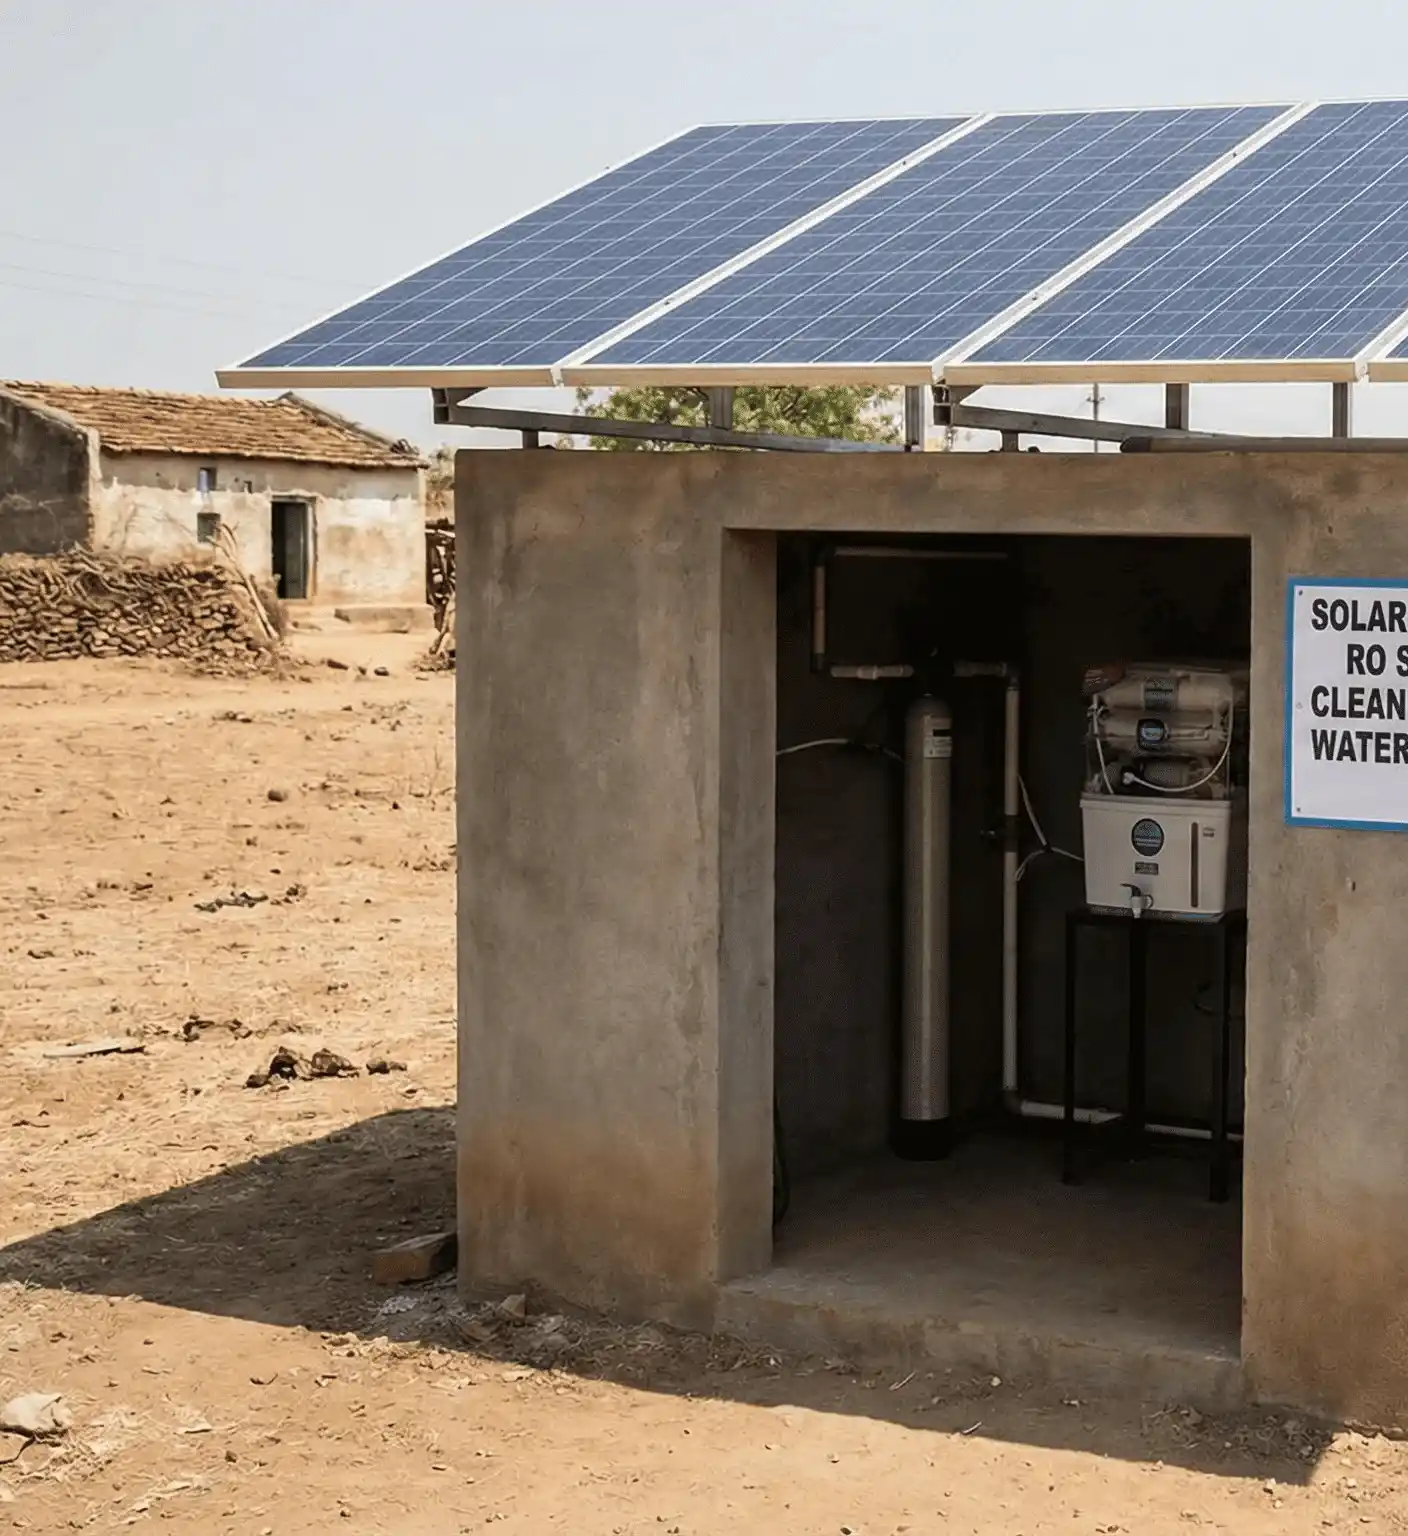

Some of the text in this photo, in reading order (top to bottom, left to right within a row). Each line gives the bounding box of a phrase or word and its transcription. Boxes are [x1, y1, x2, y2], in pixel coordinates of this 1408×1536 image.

[1311, 598, 1408, 633] SOLAR
[1346, 643, 1387, 676] RO
[1311, 685, 1406, 721] CLEAN
